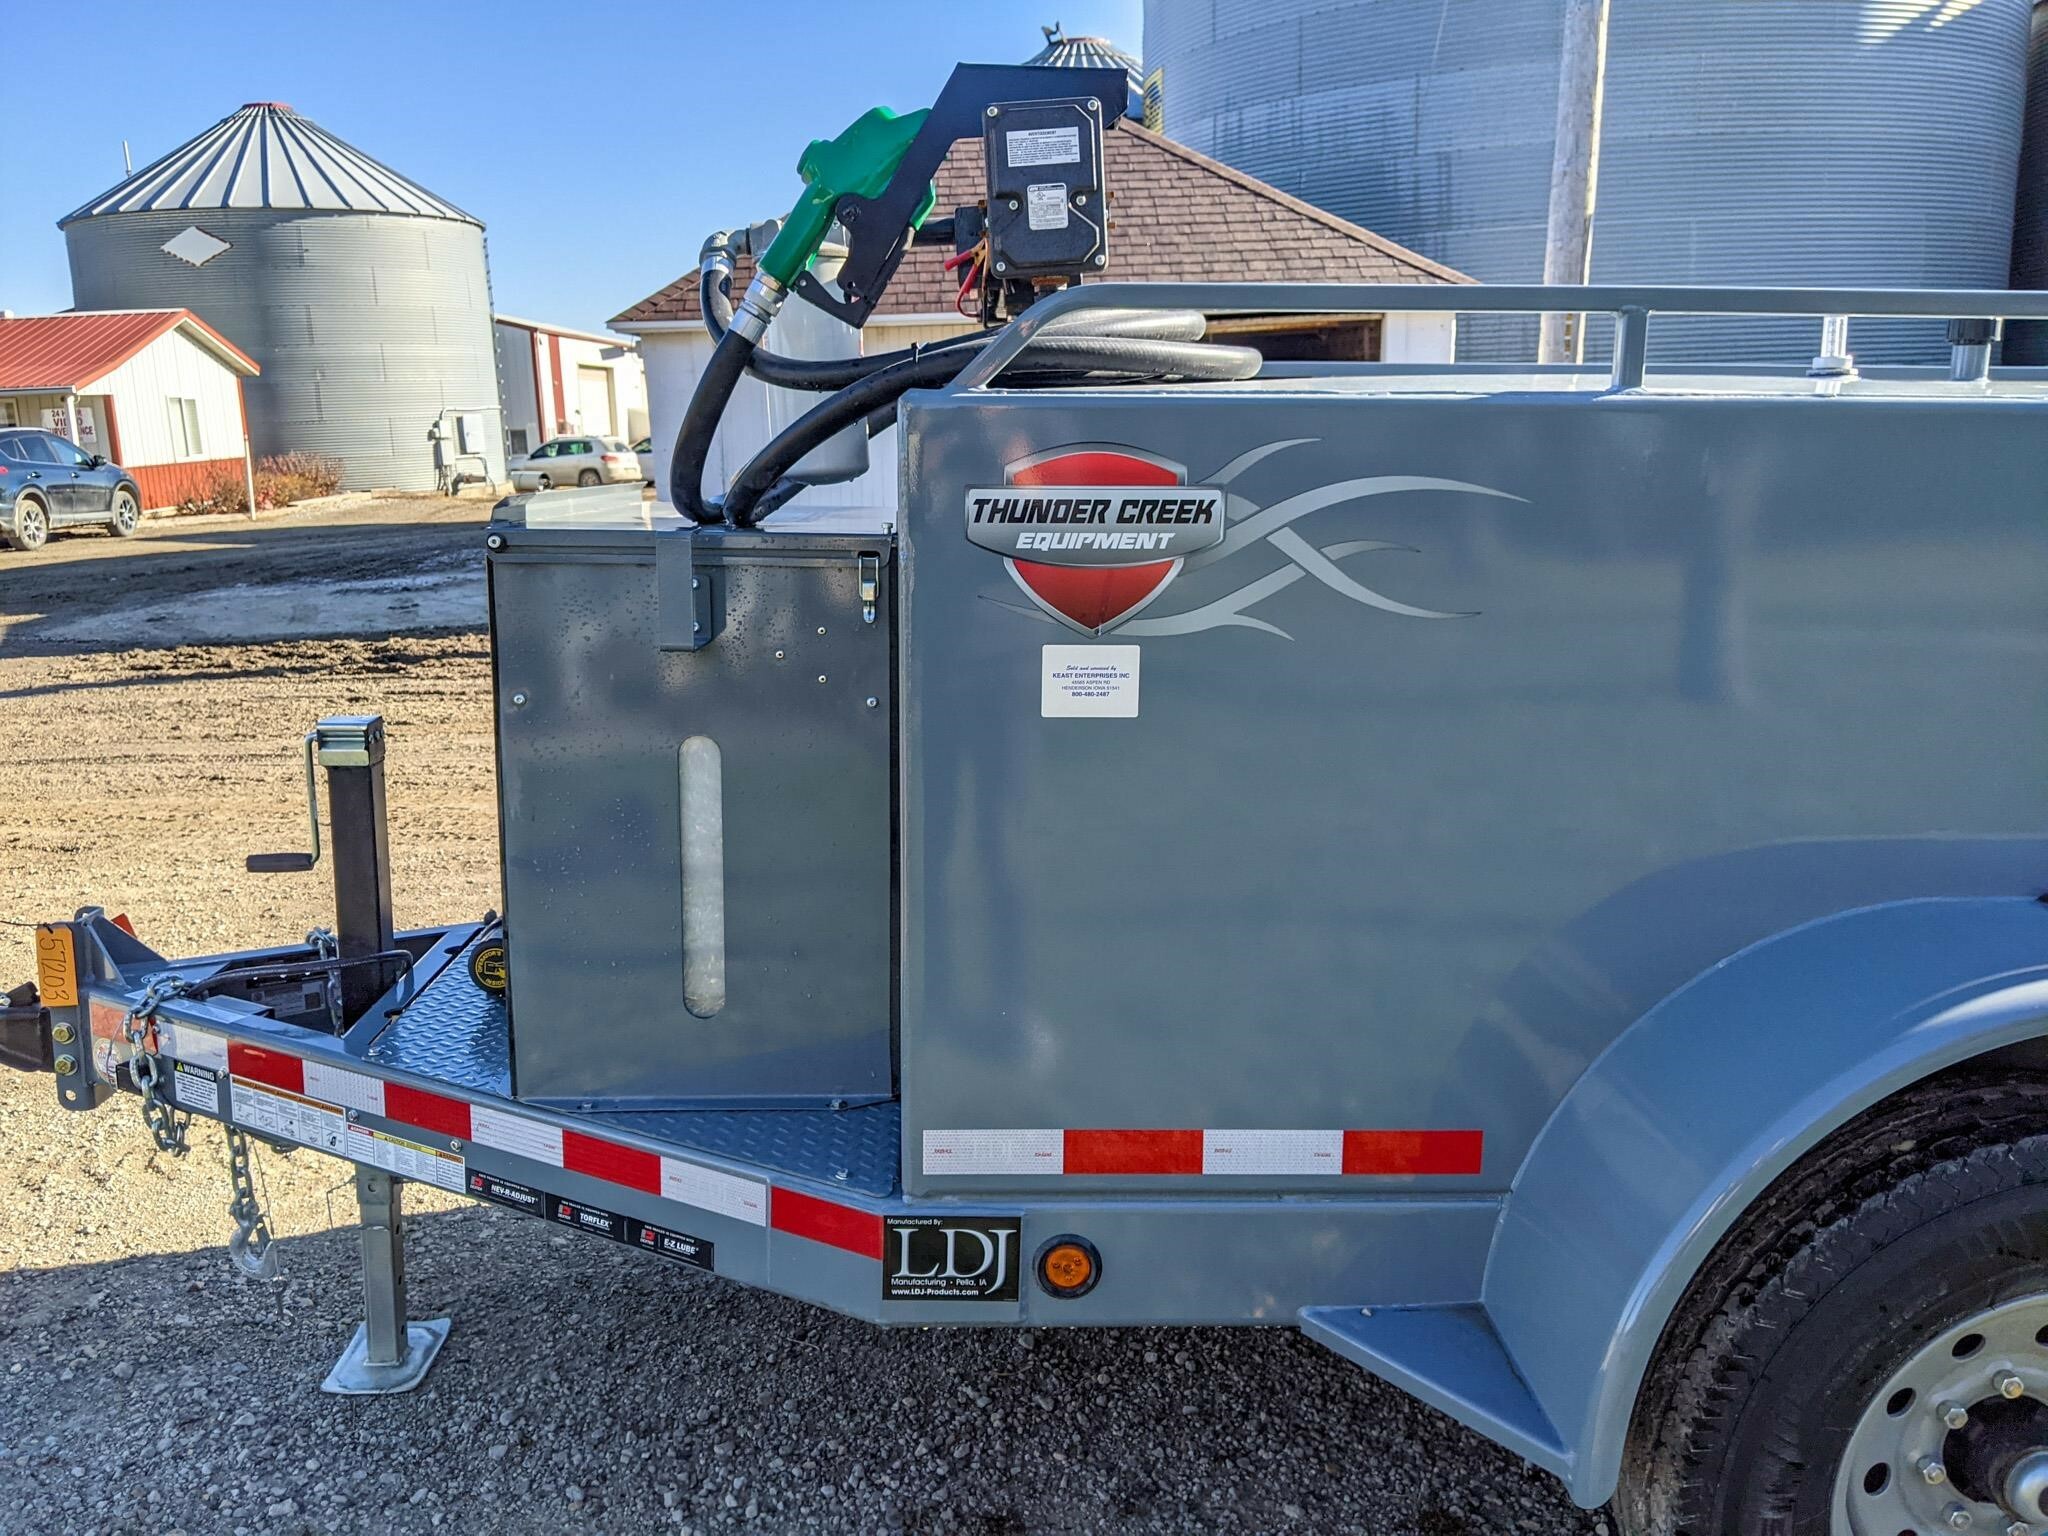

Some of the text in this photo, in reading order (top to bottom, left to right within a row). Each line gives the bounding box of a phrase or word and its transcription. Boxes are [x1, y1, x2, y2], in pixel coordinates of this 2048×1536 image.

[51, 409, 60, 417] 24
[972, 498, 1217, 524] THUNDER CREEK
[1016, 532, 1176, 551] EQUIPMENT
[39, 937, 70, 1001] 57203
[183, 1063, 215, 1082] WARNING
[491, 1184, 536, 1204] NEV-R-ADJUST
[580, 1212, 610, 1228] TORFLEX
[933, 1218, 943, 1226] By:
[664, 1238, 675, 1248] E-Z
[676, 1241, 696, 1255] LUBE
[891, 1228, 1017, 1295] LDJ
[891, 1278, 947, 1287] Manufacturing
[956, 1278, 977, 1287] Pella,
[891, 1288, 979, 1296] www.LDJ-Products.com
